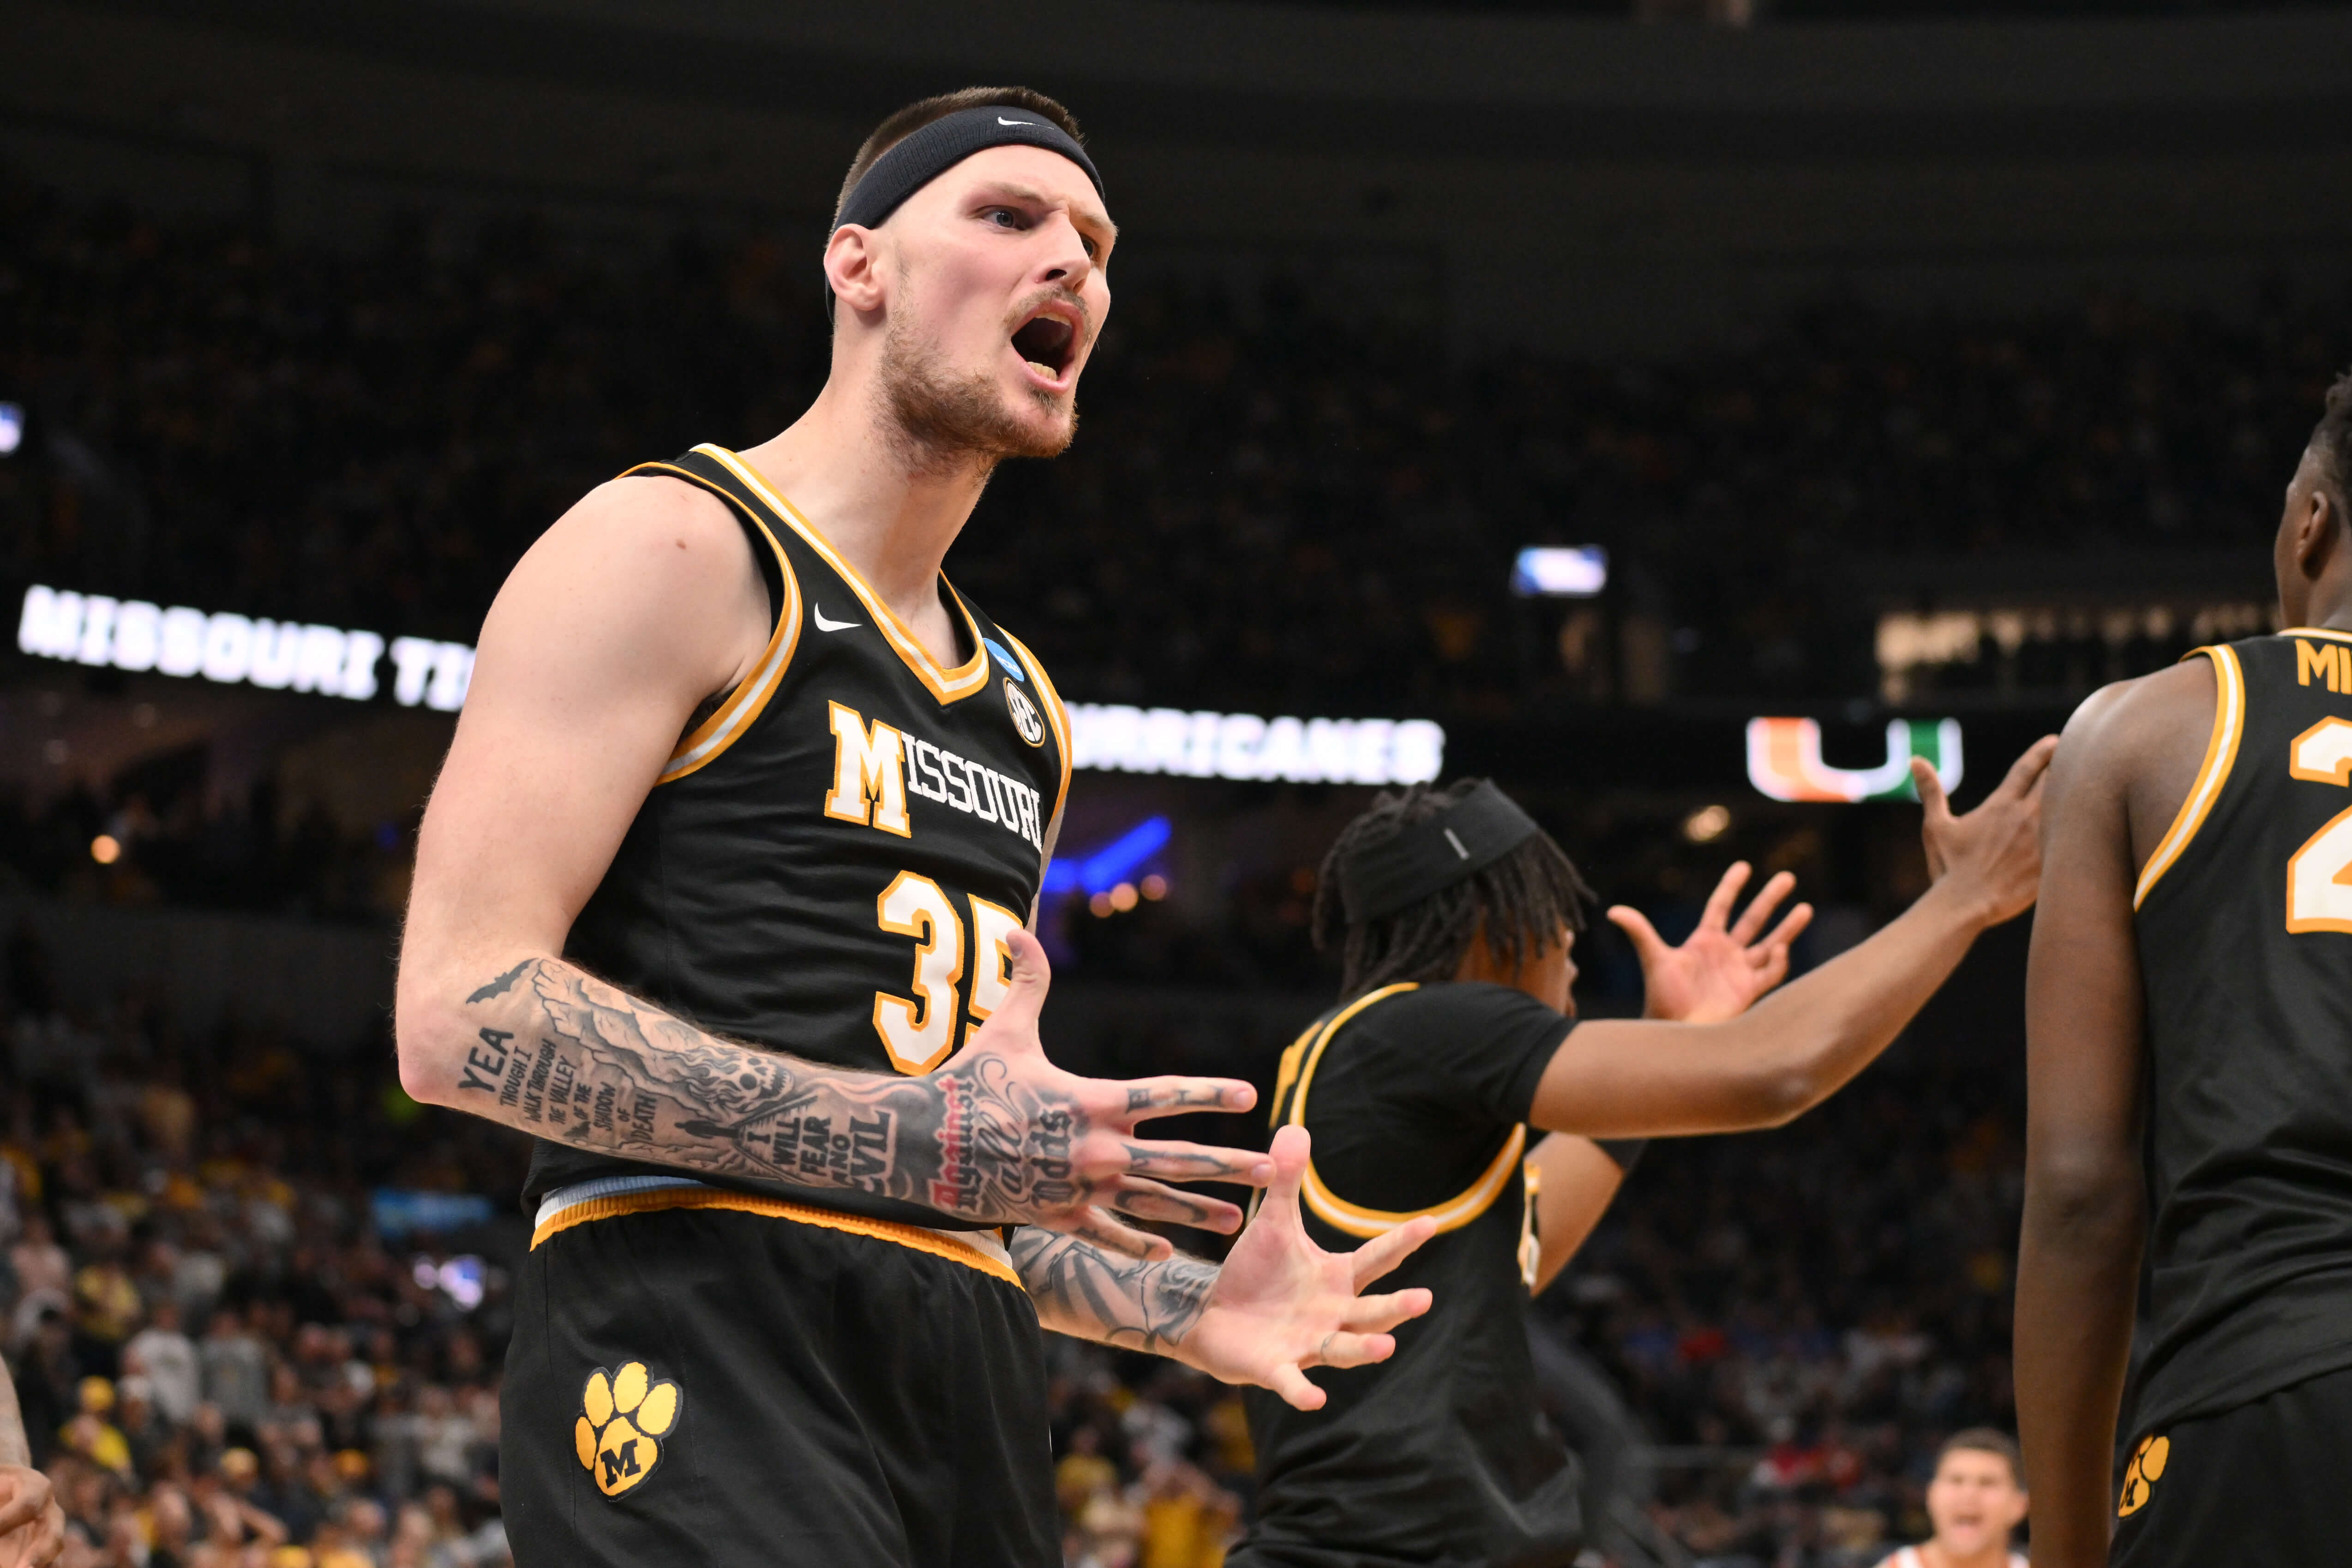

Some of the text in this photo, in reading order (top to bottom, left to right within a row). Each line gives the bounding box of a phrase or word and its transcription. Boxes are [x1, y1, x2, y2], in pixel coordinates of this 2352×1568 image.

[18, 584, 476, 712] MISSOURI TI
[1007, 682, 1042, 742] SEC
[824, 700, 1042, 854] MISSOURI
[458, 1027, 514, 1093] YEA
[500, 1046, 532, 1107] THOUGH I
[523, 1039, 557, 1123] WALK THROUGH
[549, 1055, 577, 1125] THE VALLEY
[573, 1083, 591, 1120] OF THE
[593, 1081, 616, 1131] SHADOW
[617, 1107, 630, 1123] OF
[630, 1094, 657, 1141] DEATH
[747, 1131, 771, 1143] I
[773, 1115, 800, 1165] WILL
[799, 1115, 832, 1177] FEAR
[931, 1075, 981, 1212] Against
[600, 1438, 641, 1489] M
